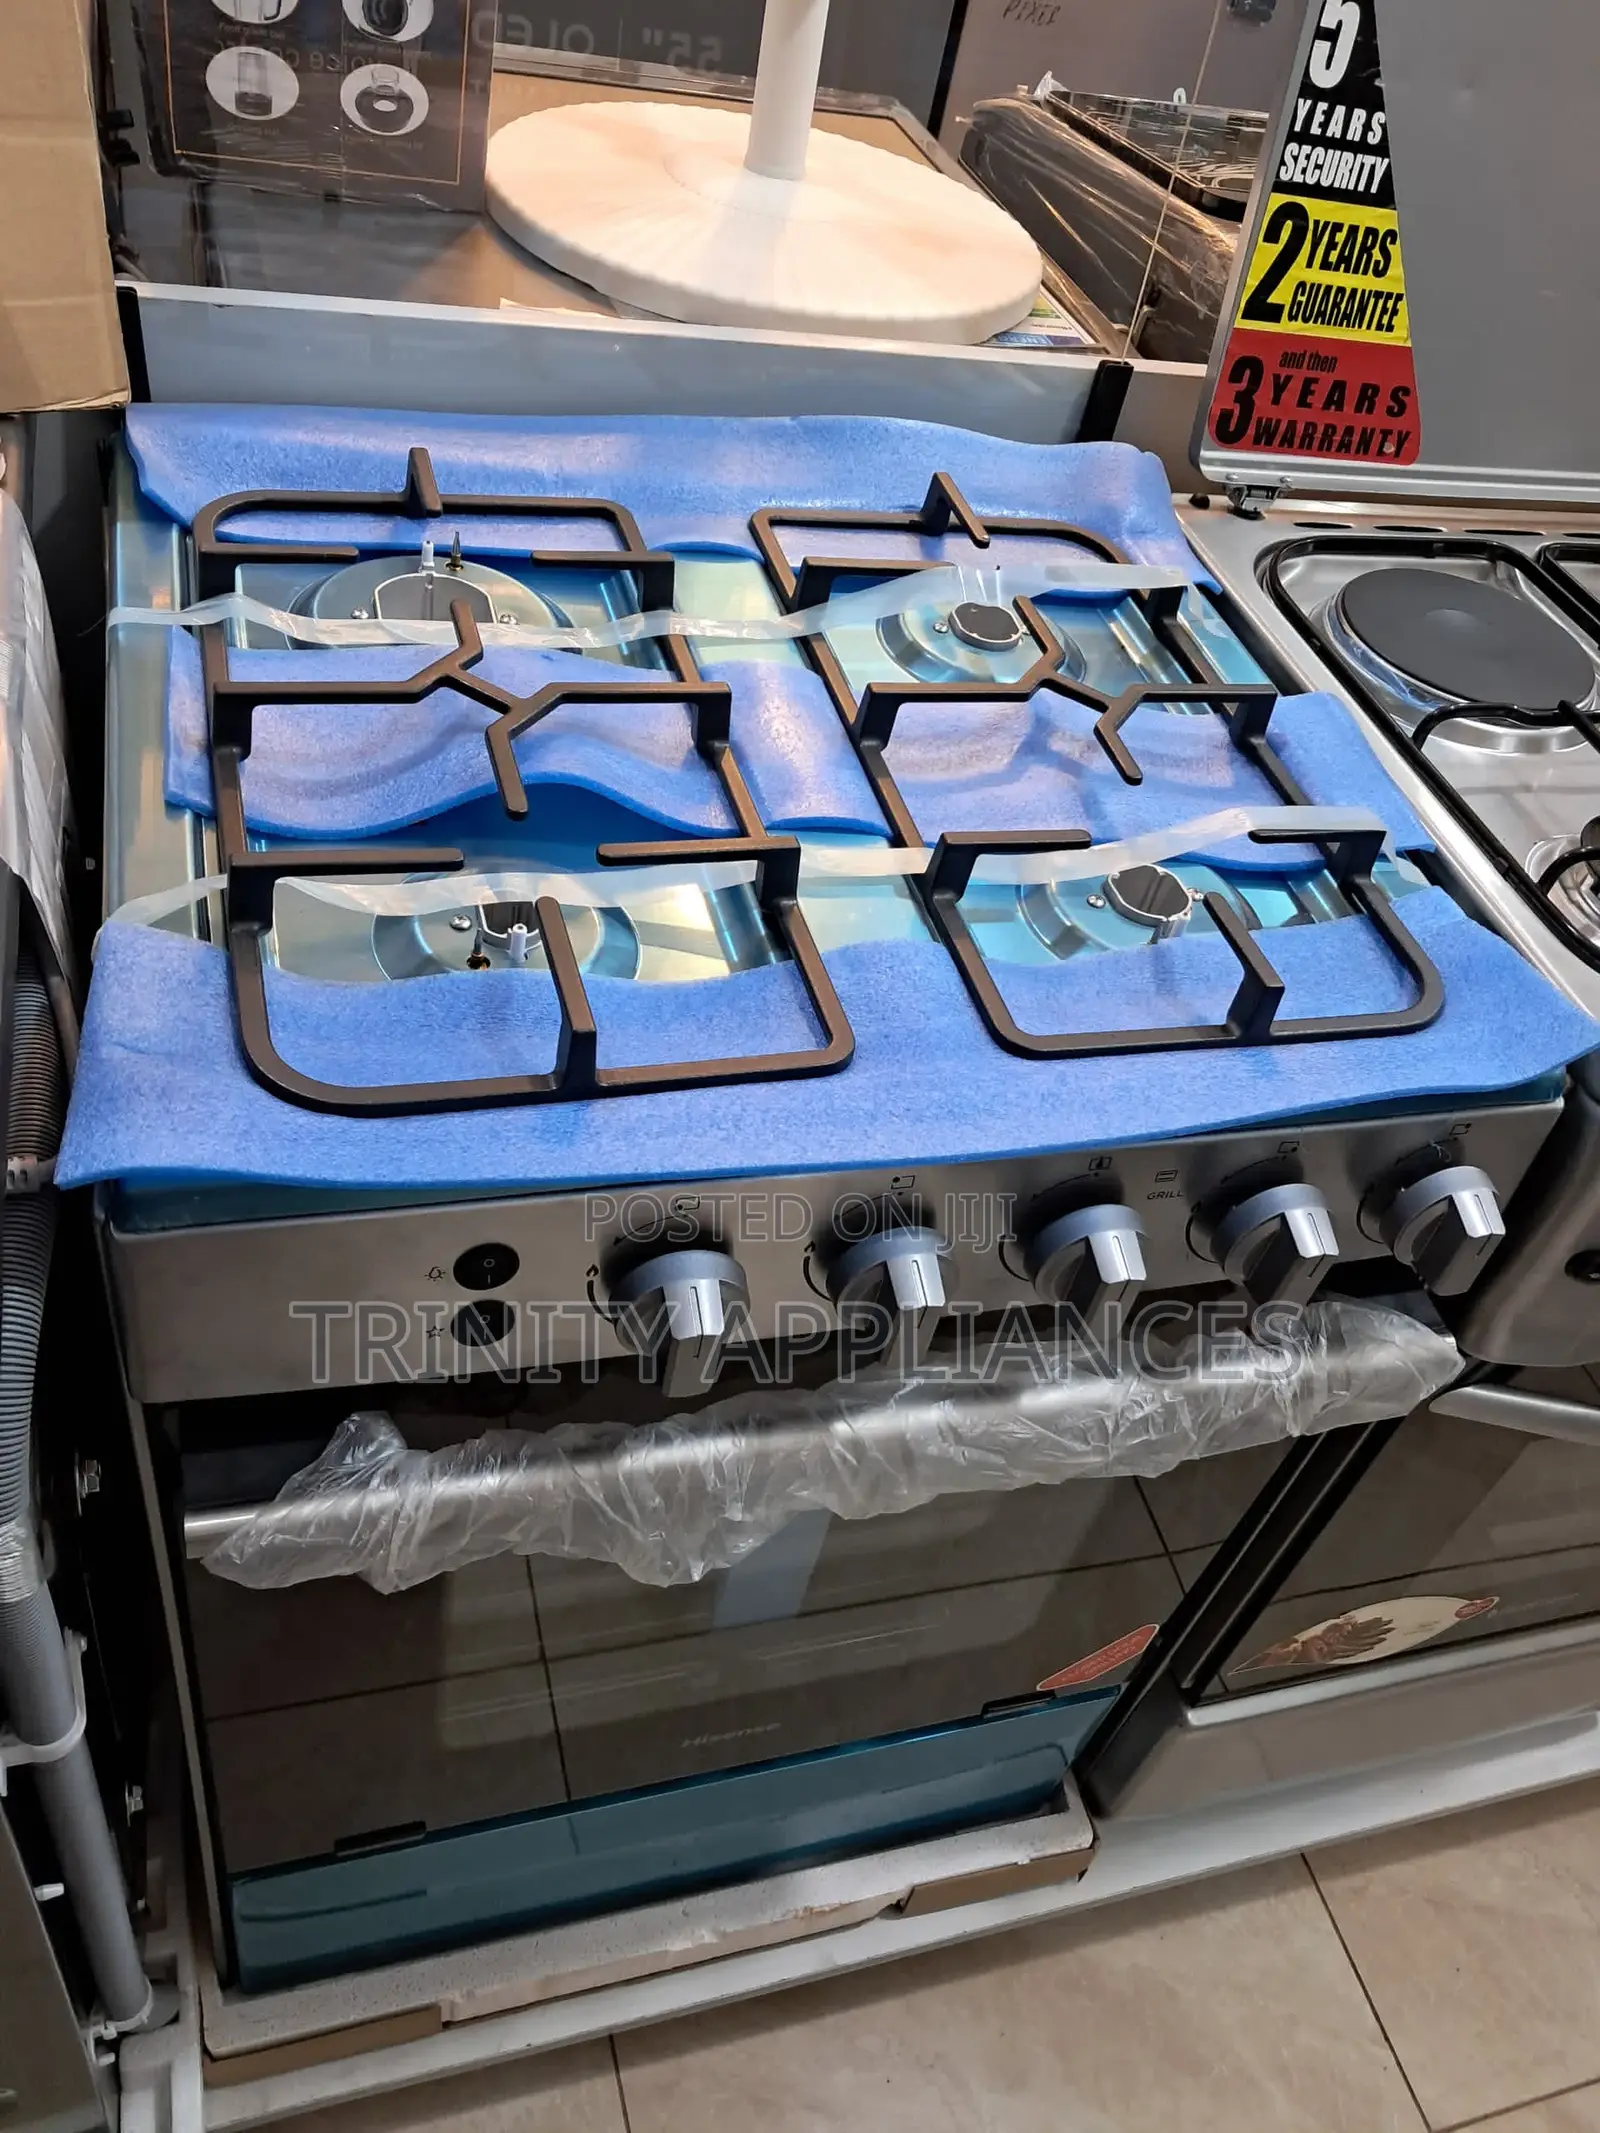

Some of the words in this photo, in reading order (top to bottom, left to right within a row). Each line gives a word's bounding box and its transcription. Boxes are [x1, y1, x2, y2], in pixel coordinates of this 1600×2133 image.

[1309, 0, 1361, 88] 5
[1294, 98, 1386, 145] YEARS
[1279, 143, 1390, 194] SECURITY
[1241, 201, 1310, 323] 2
[1305, 219, 1398, 278] YEARS
[1287, 281, 1405, 333] GUARANTEE
[1279, 350, 1306, 370] and
[1306, 351, 1338, 373] then
[1215, 355, 1264, 445] 3
[1271, 373, 1411, 418] YEARS
[1252, 417, 1412, 458] WARRANTY
[1147, 1189, 1185, 1200] GRILL
